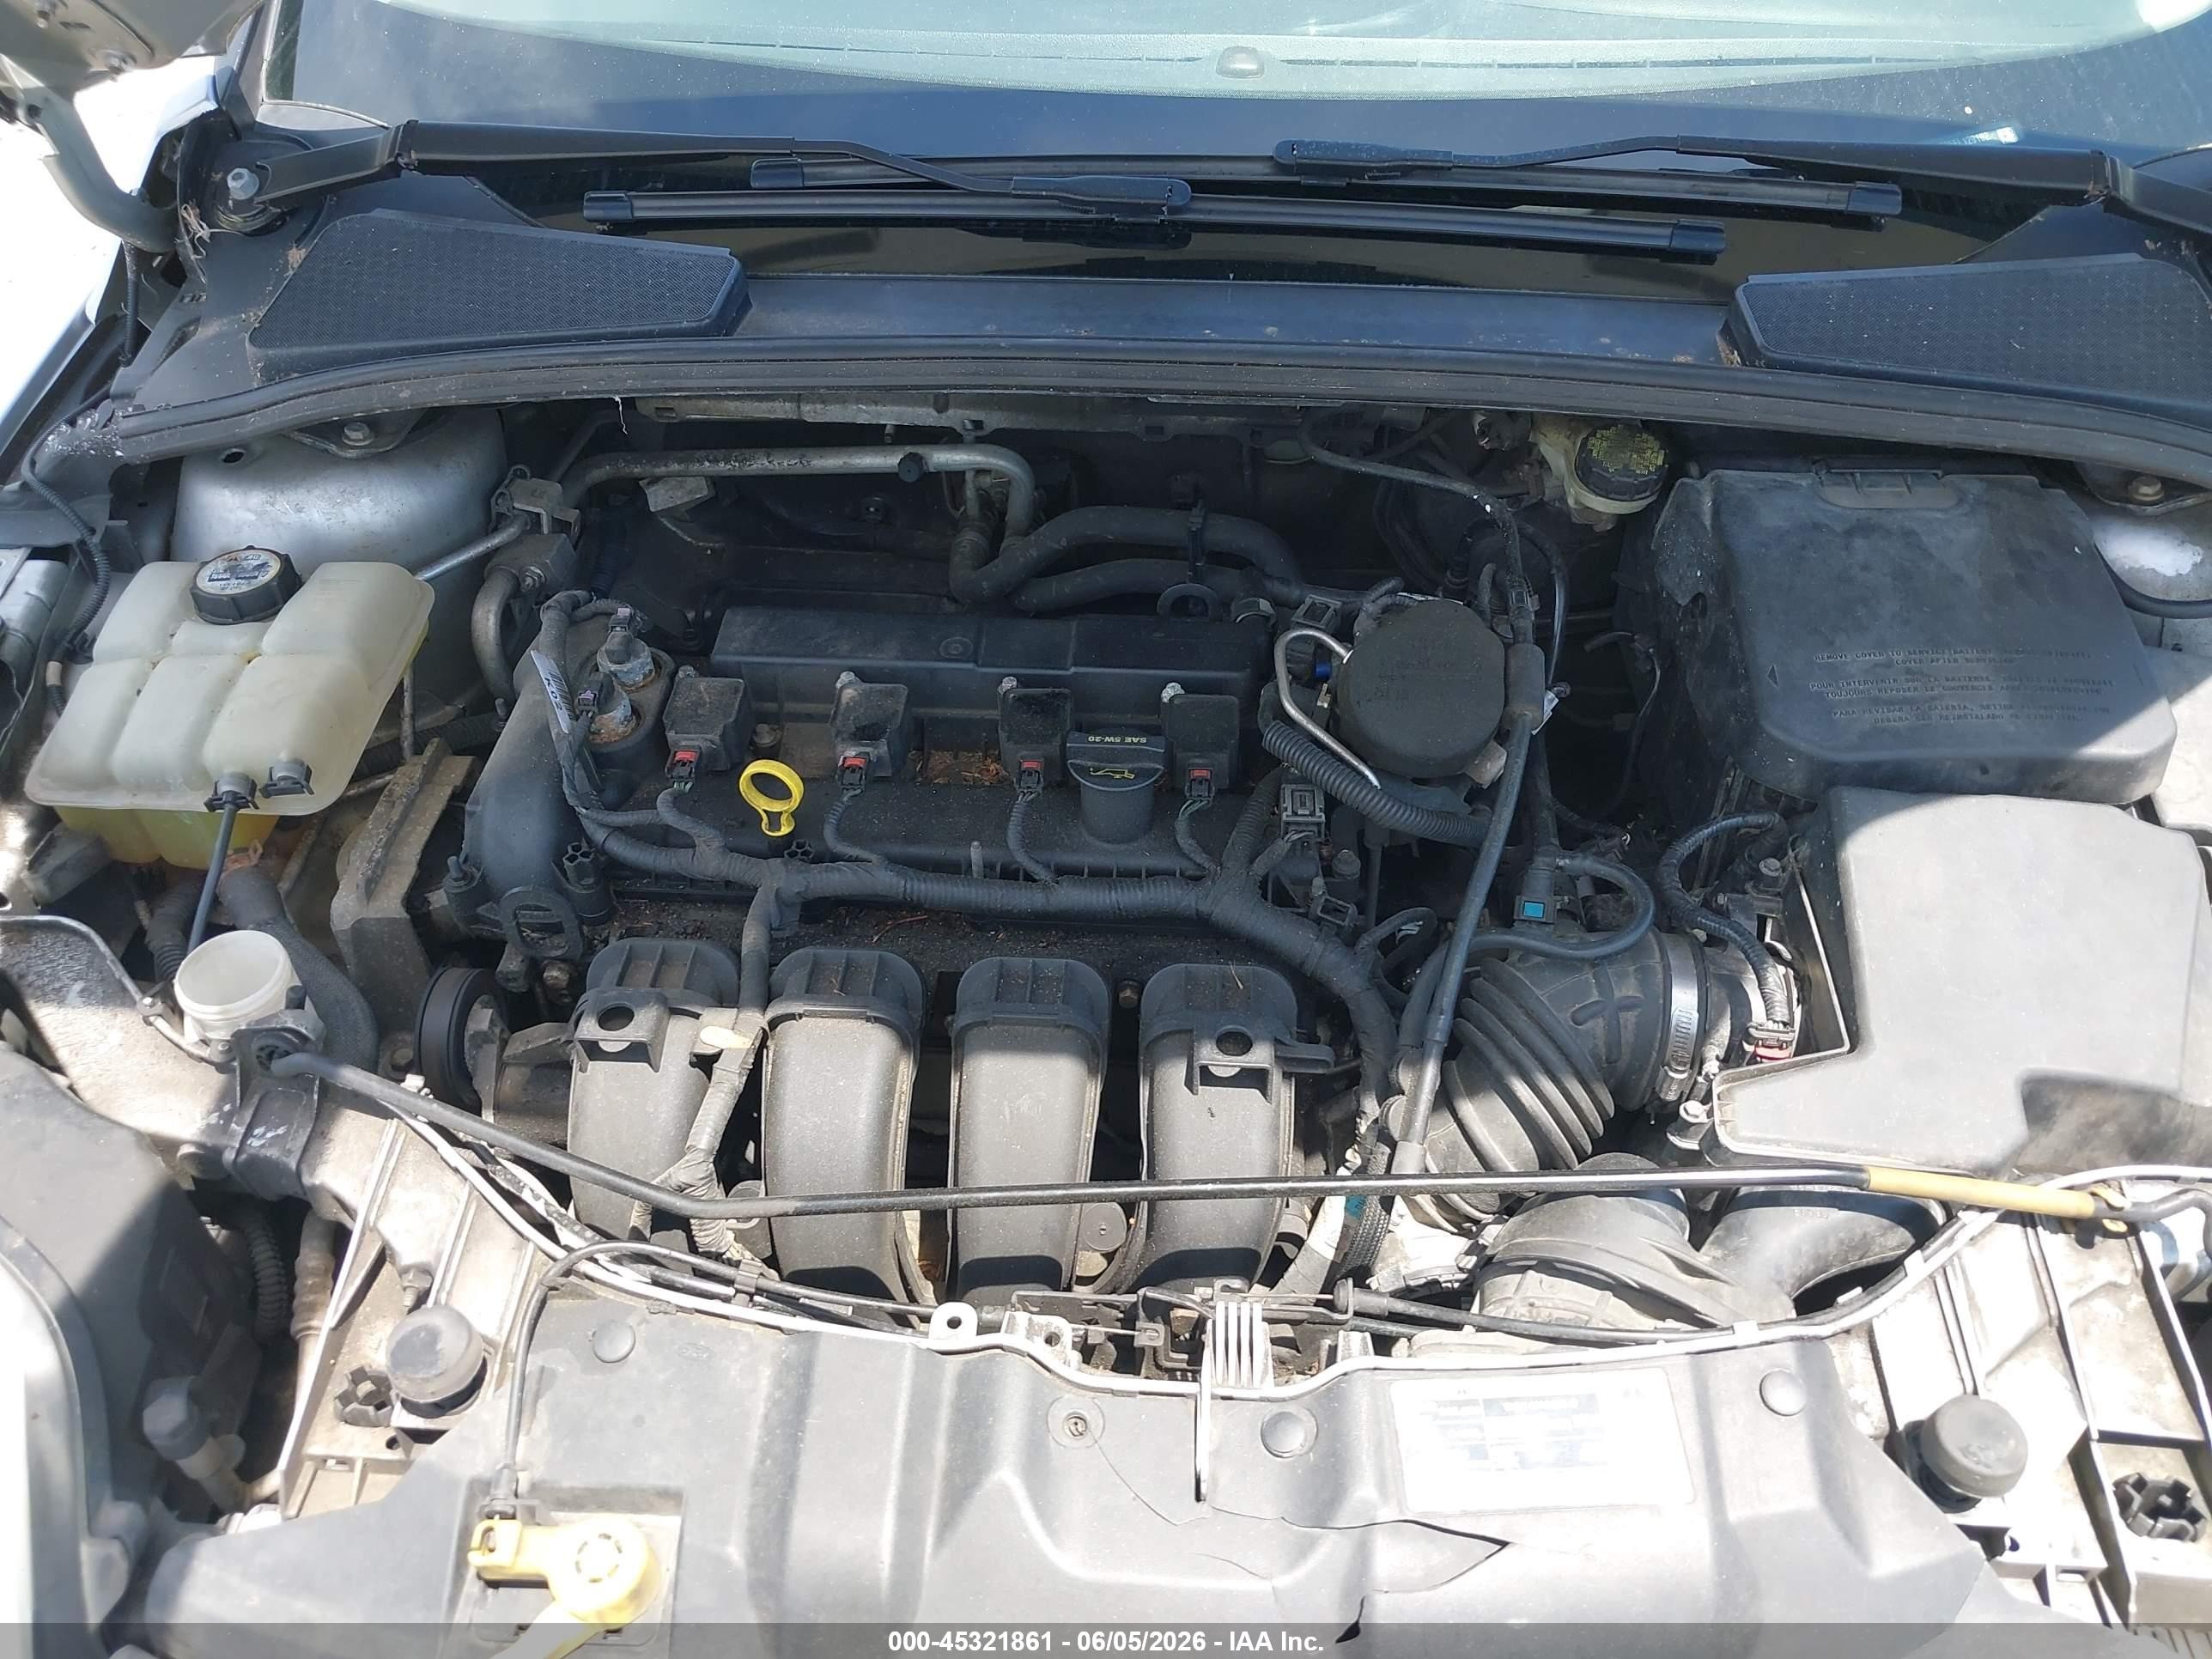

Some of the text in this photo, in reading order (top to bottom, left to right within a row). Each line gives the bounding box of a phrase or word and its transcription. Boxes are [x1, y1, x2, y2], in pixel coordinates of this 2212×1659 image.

[1814, 653, 1849, 662] REMOVE
[1855, 651, 1885, 659] COVER
[1907, 648, 1945, 657] SERVICE
[1811, 681, 1835, 690] POUR
[1840, 678, 1899, 688] INTERVENIR
[1826, 689, 1873, 698] TOUJOURS
[1878, 686, 1918, 695] REPOSER
[1832, 708, 1856, 717] PARA
[1863, 706, 1904, 714] REVISAR
